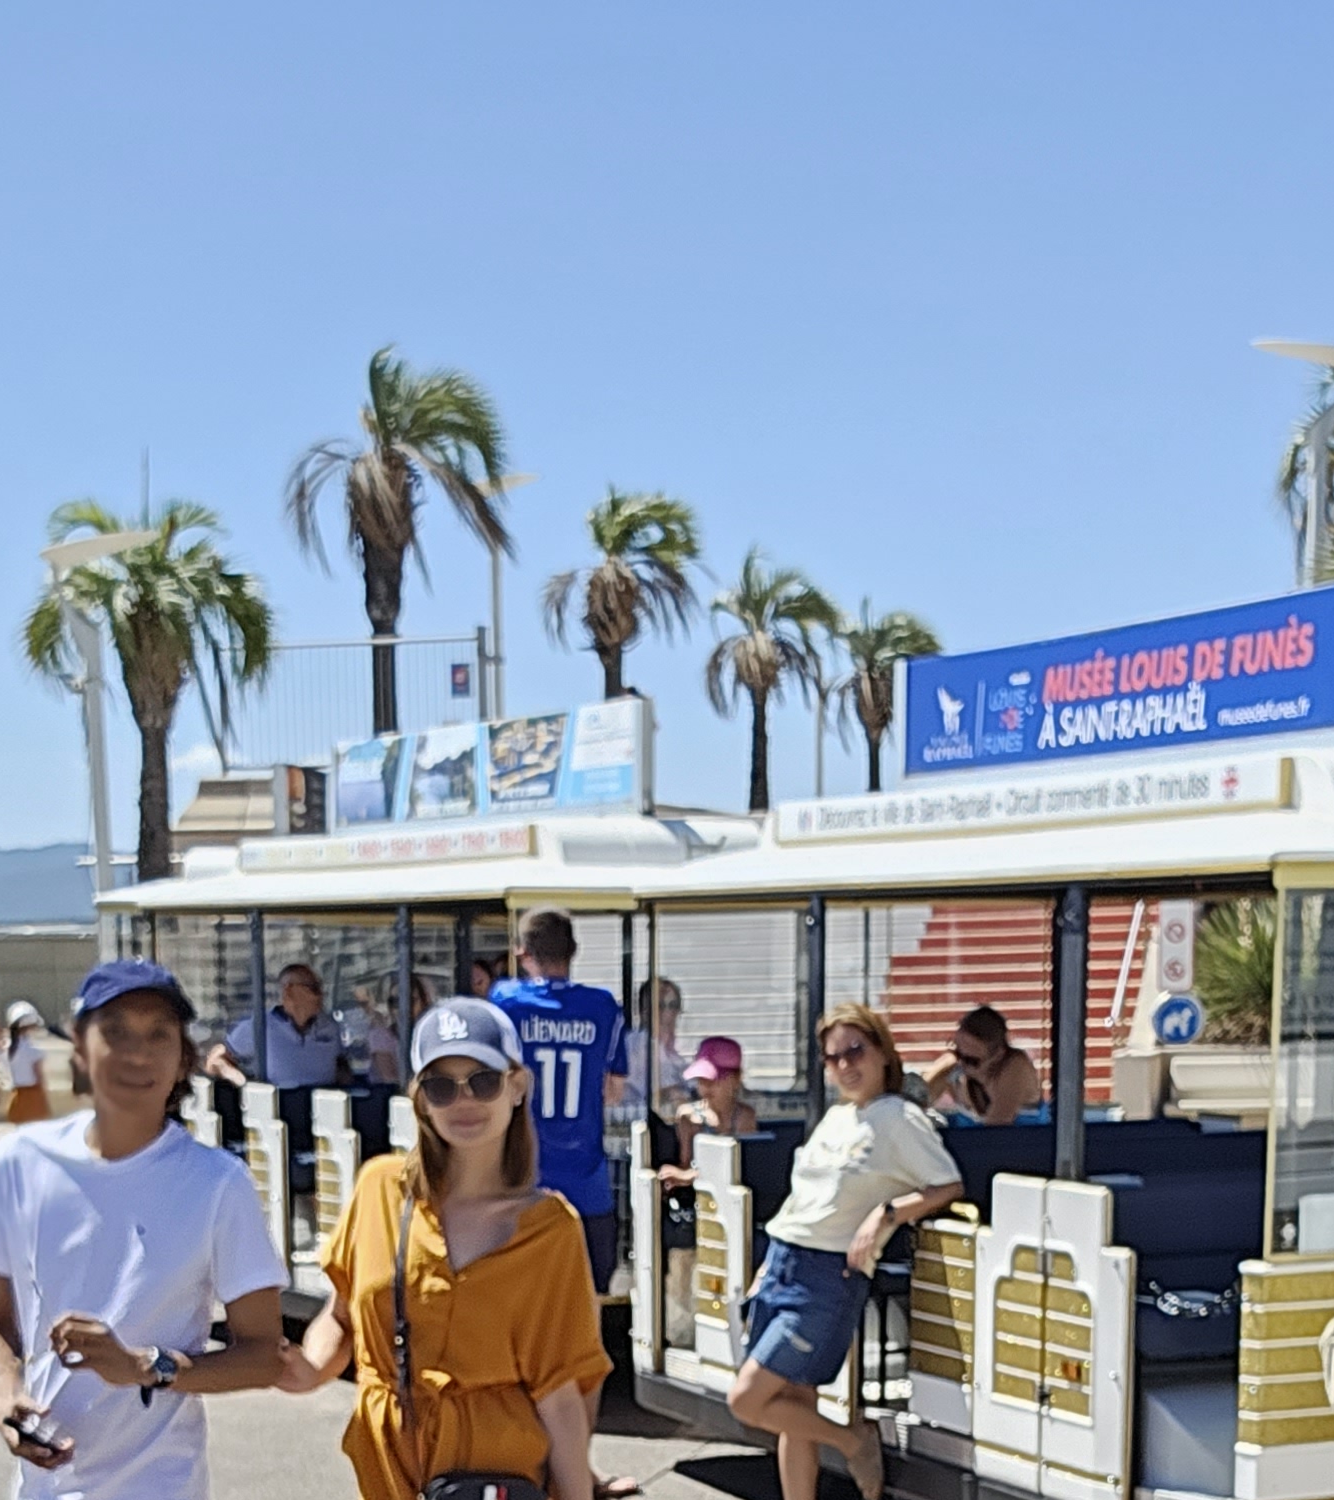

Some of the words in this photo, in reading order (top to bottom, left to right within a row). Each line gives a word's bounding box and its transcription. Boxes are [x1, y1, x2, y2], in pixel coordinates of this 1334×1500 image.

[1042, 648, 1116, 703] MUSÉE
[1119, 643, 1189, 693] LOUIS
[1192, 637, 1228, 682] DE
[1229, 613, 1315, 677] FUNÈS
[1038, 701, 1056, 750] À
[1157, 769, 1210, 801] minutes
[535, 1048, 583, 1118] 11
